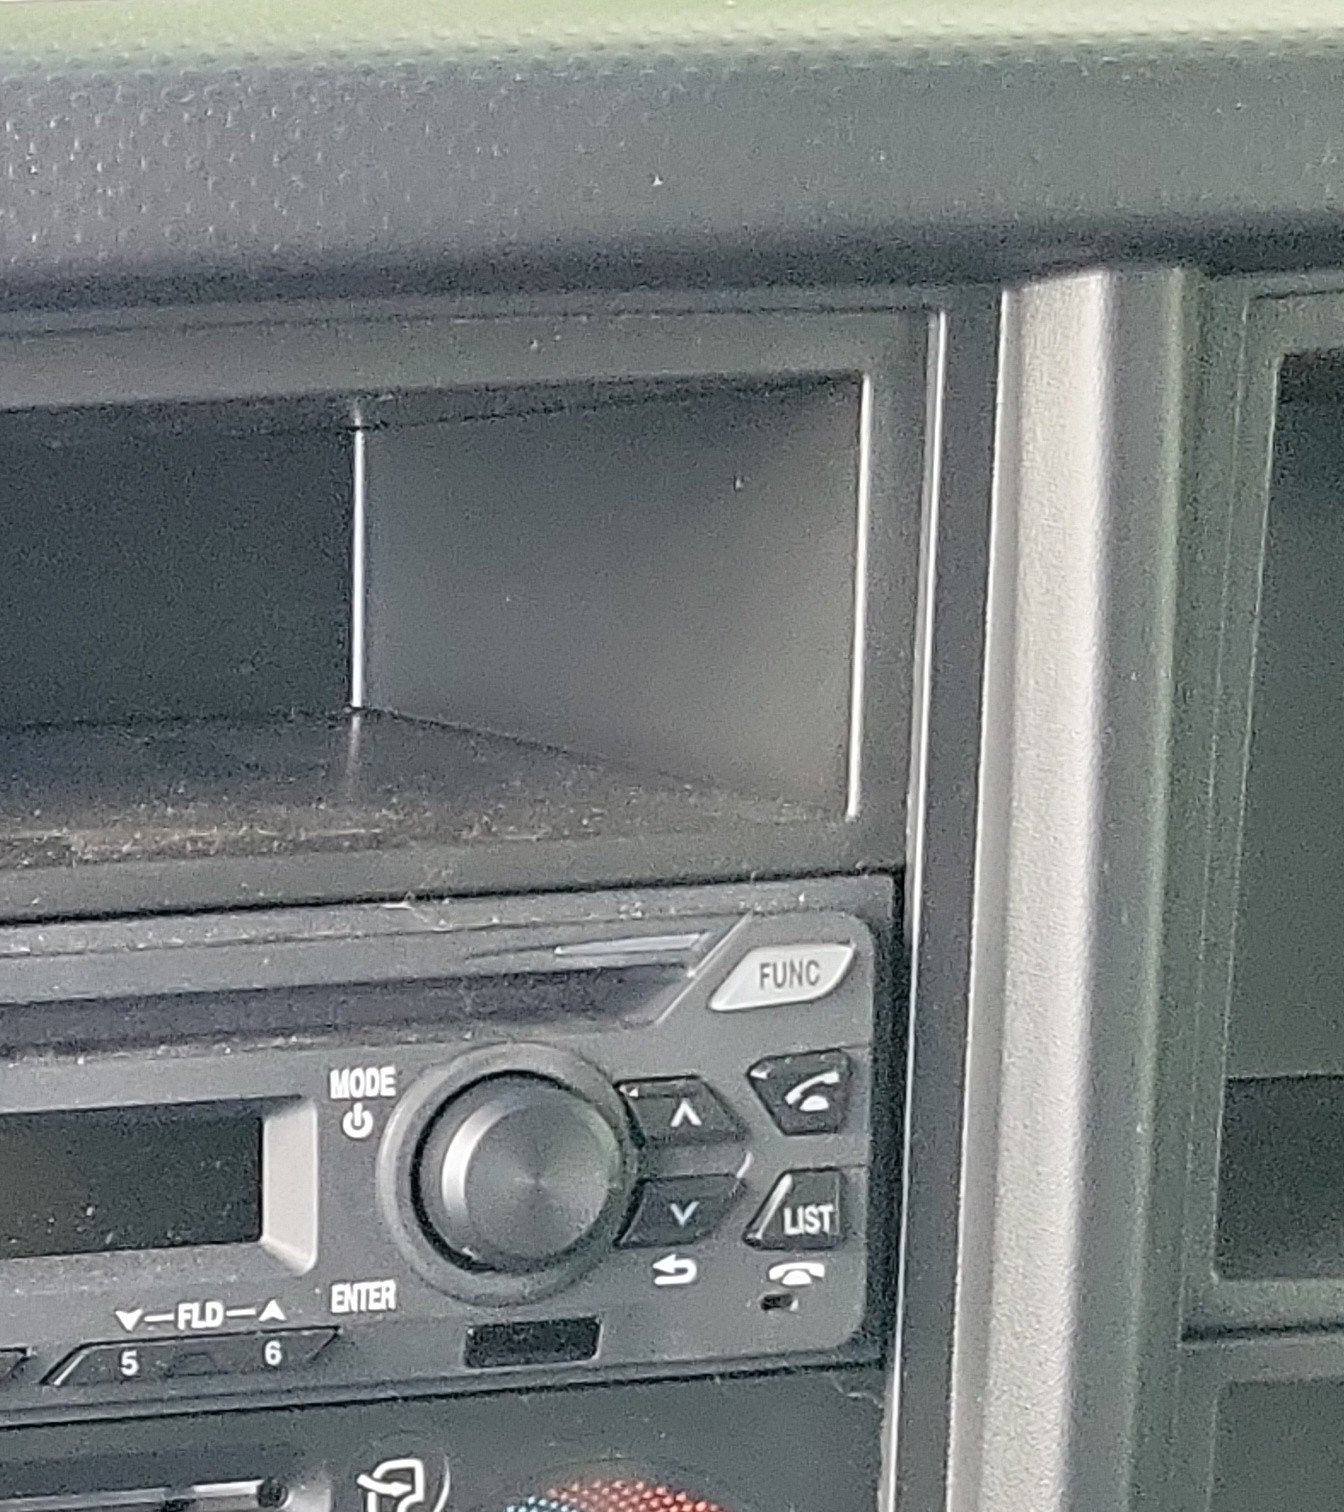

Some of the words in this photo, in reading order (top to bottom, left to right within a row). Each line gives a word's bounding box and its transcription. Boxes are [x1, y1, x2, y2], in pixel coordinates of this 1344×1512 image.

[759, 960, 821, 988] FUNC
[330, 1066, 395, 1099] MODE
[784, 1204, 833, 1235] LIST
[331, 1281, 396, 1312] ENTER
[178, 1302, 222, 1329] FLD
[120, 1350, 139, 1375] 5
[265, 1341, 282, 1366] 6
